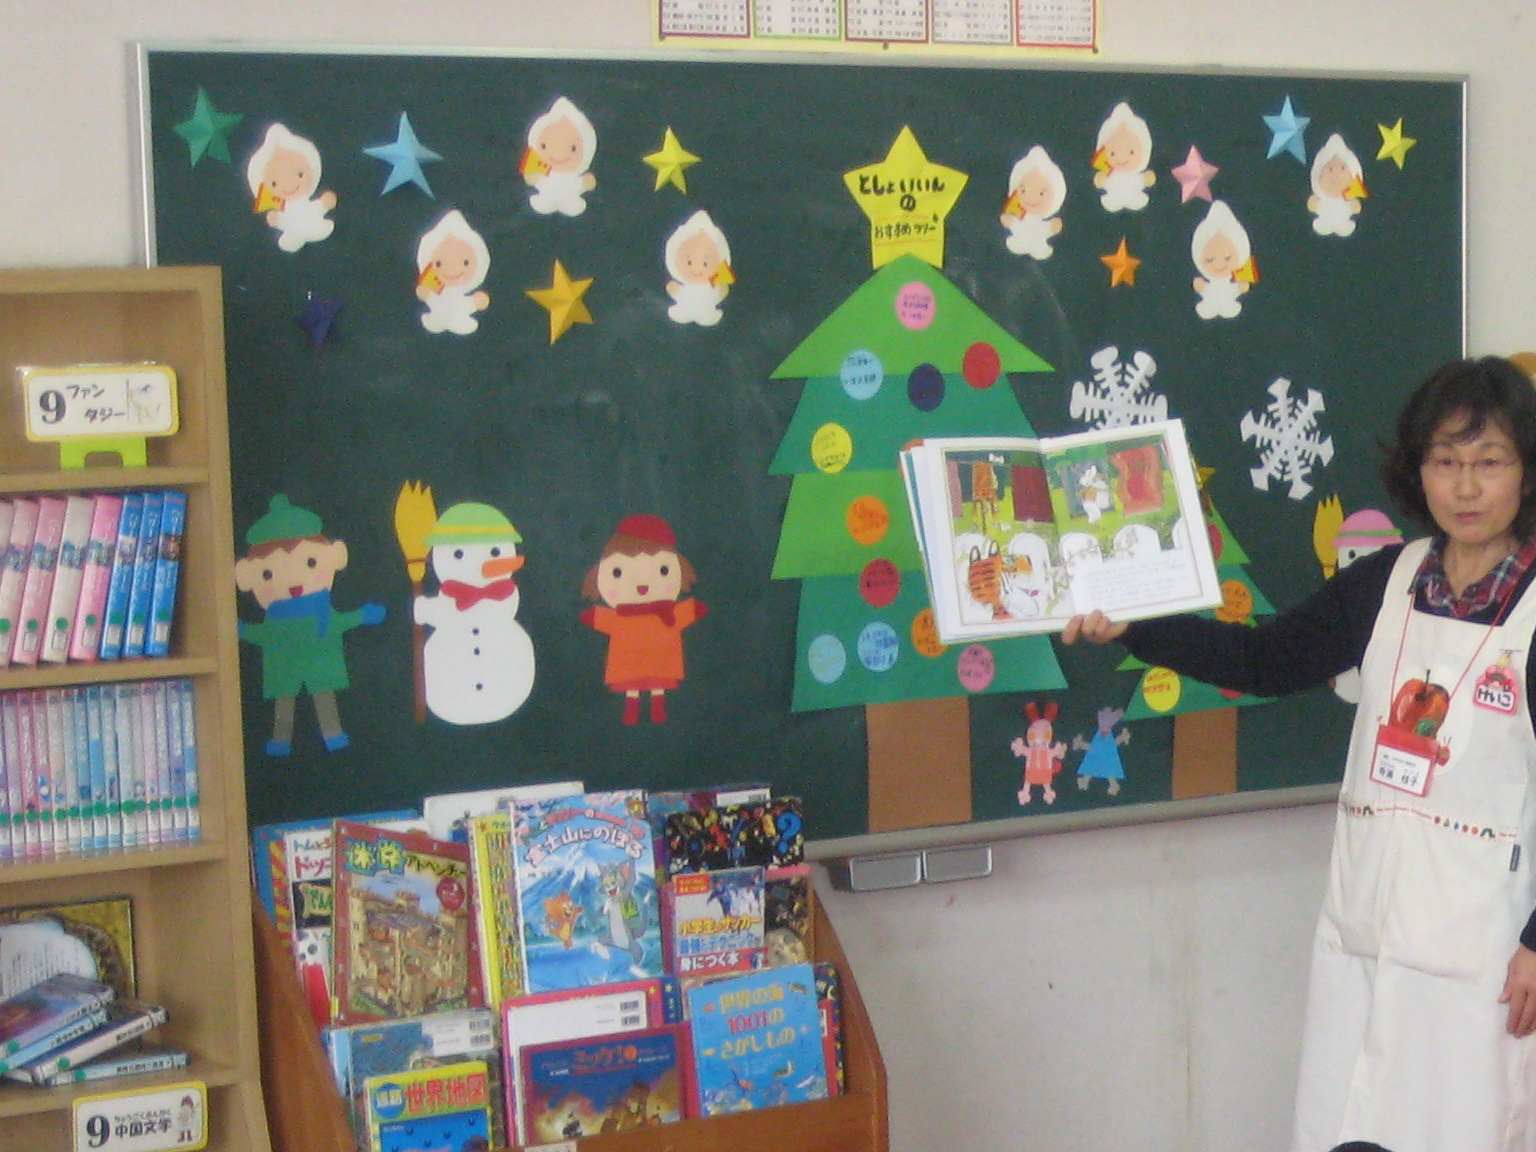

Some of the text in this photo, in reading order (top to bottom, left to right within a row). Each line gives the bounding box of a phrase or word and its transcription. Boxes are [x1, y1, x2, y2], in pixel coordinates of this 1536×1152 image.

[858, 173, 945, 196] としょいいん
[899, 194, 917, 212] の
[66, 383, 106, 400] ファン
[38, 388, 67, 424] 9
[405, 1073, 487, 1114] 世界地図
[86, 1115, 110, 1148] 9
[114, 1118, 172, 1138] 中国文学
